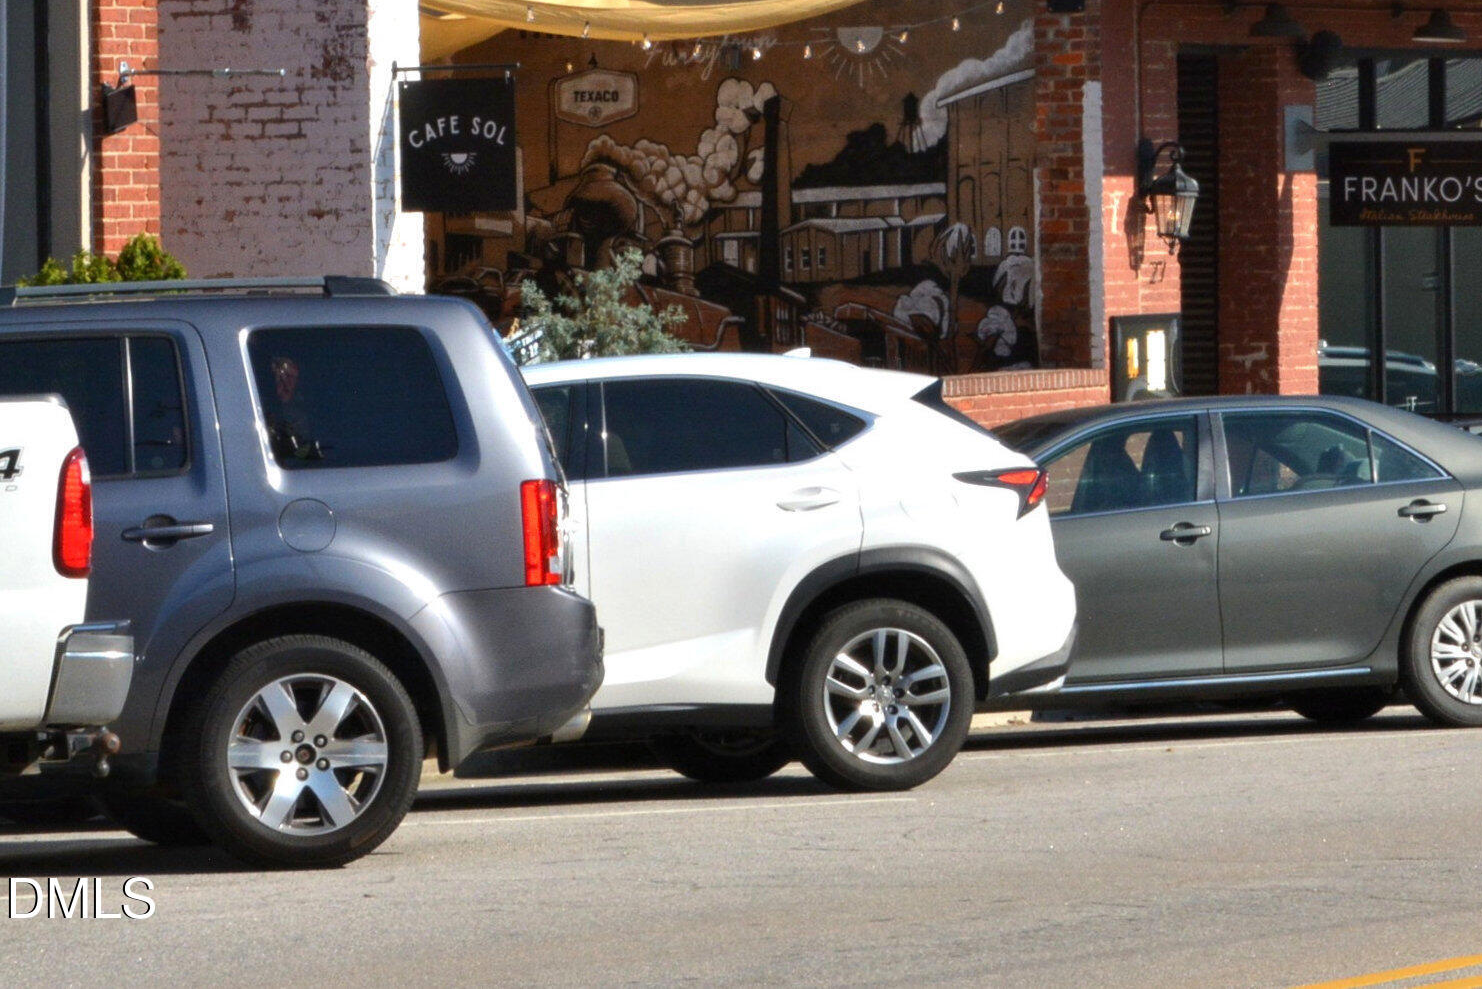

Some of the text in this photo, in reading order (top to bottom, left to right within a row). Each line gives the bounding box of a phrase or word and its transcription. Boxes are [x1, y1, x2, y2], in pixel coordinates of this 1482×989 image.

[573, 90, 619, 103] TEXACO
[408, 115, 506, 148] CAFE SOL
[1407, 148, 1426, 173] F
